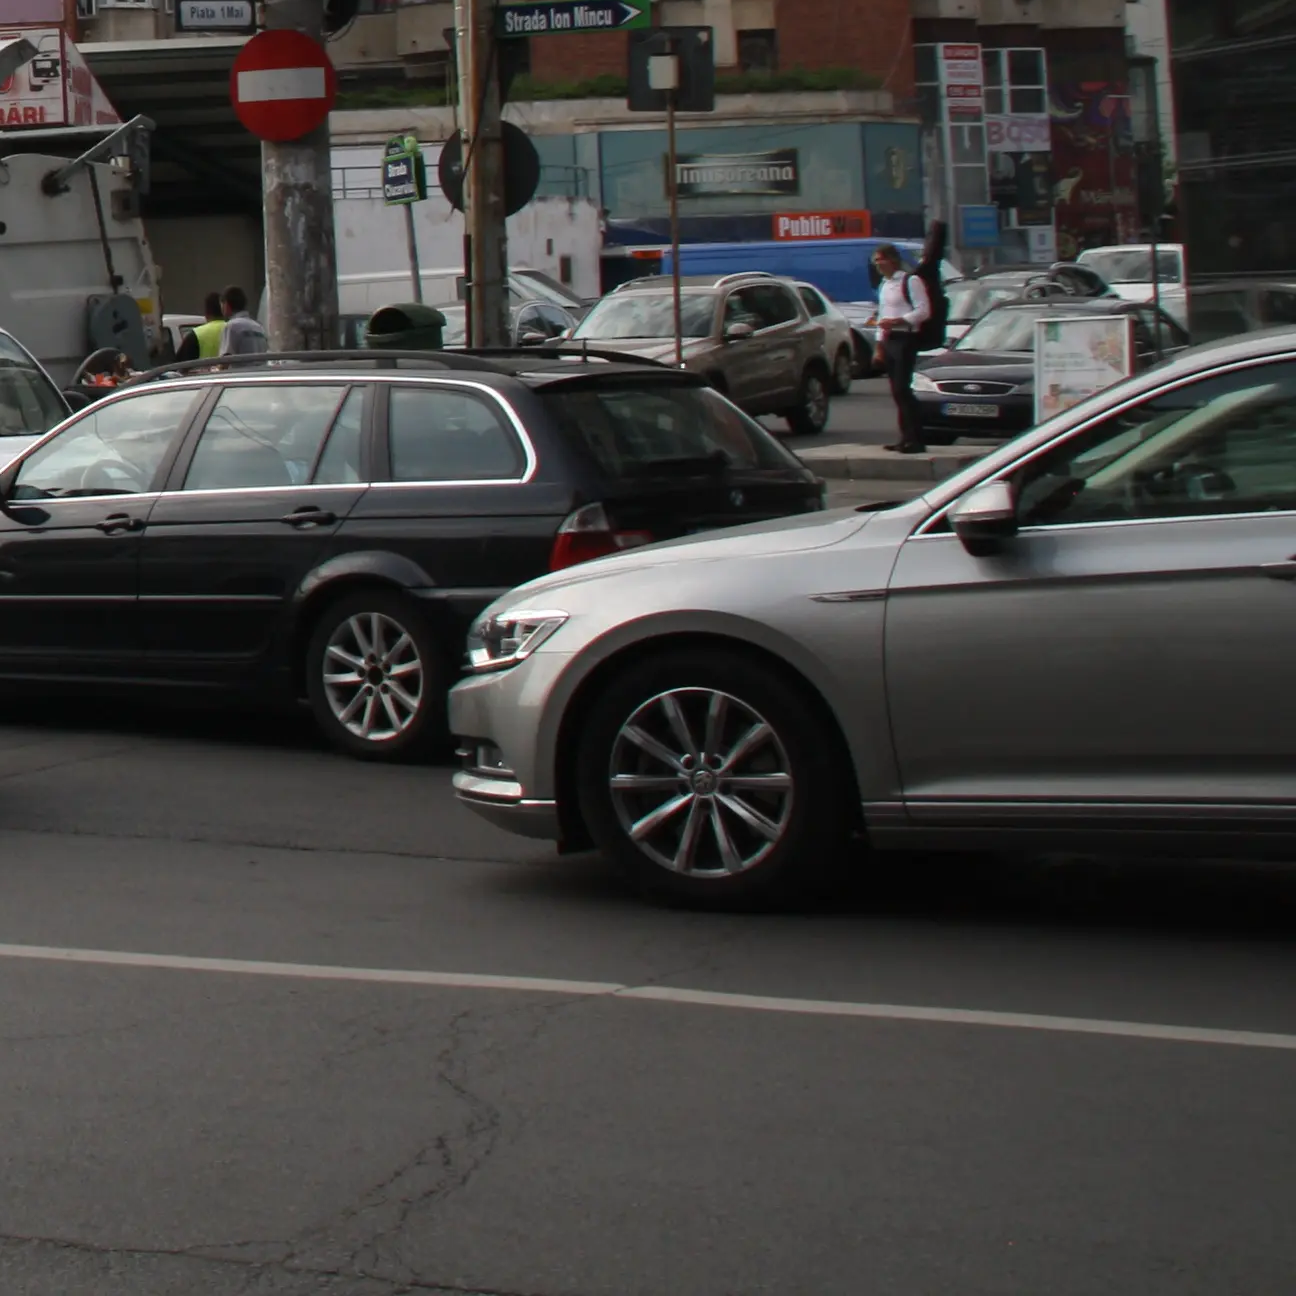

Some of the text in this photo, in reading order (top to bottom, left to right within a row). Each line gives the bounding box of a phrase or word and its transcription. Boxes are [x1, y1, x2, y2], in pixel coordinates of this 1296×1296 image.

[505, 6, 612, 32] Strada Ion Mincu
